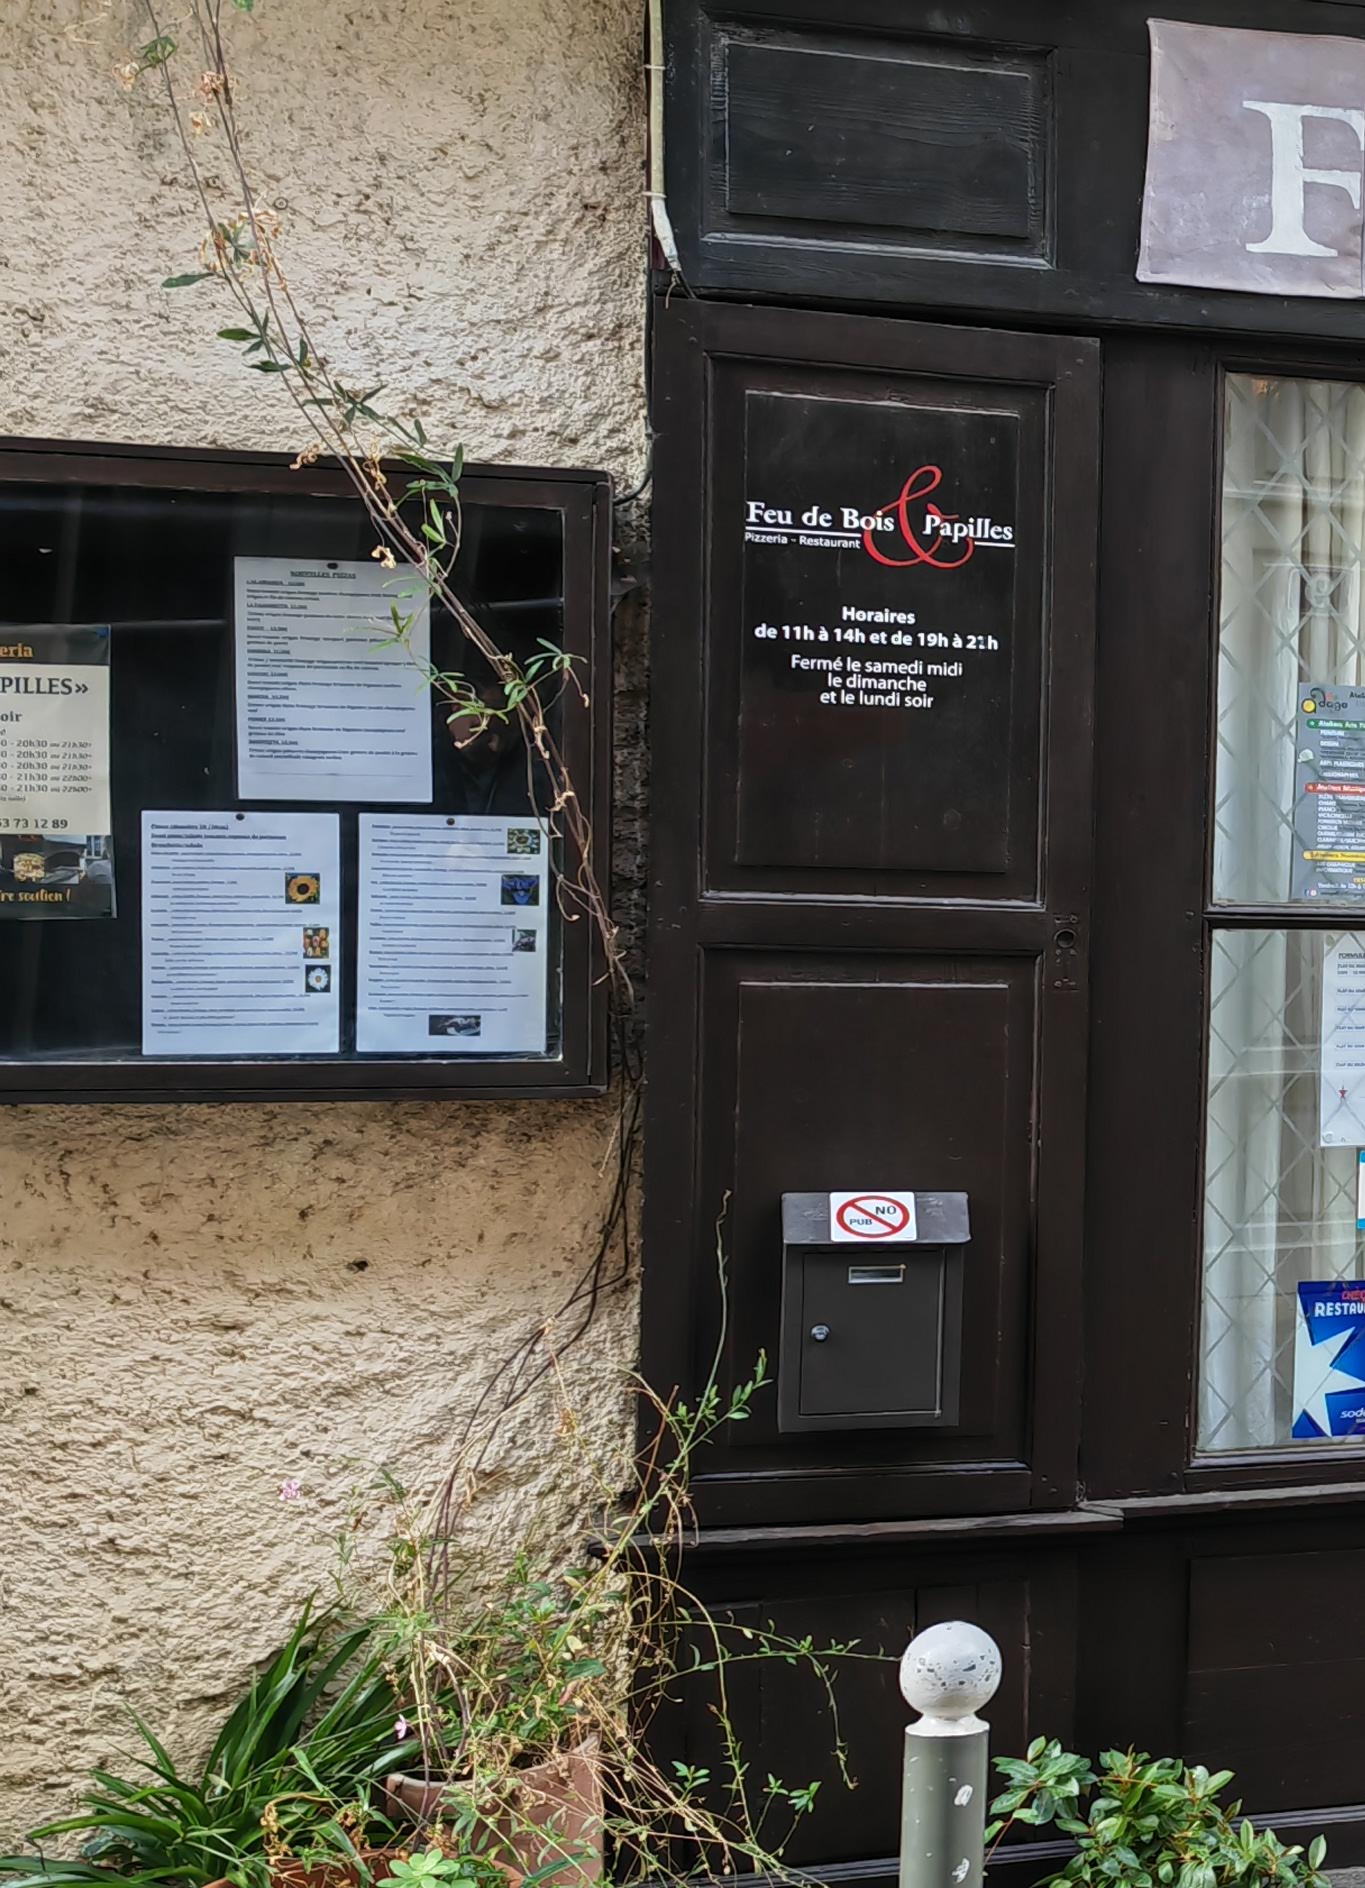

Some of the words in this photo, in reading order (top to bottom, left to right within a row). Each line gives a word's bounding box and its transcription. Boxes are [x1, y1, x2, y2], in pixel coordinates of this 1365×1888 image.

[746, 501, 793, 525] Feu
[802, 506, 832, 527] de
[841, 507, 894, 532] Bois
[923, 514, 1014, 543] Papilles
[745, 532, 788, 544] Pizzeria
[799, 535, 860, 549] Restaurant
[842, 606, 915, 624] Horaires
[754, 623, 778, 639] de
[782, 625, 814, 641] 11h
[818, 625, 830, 642] à
[834, 628, 865, 643] 14h
[869, 632, 887, 644] et
[891, 630, 913, 646] de
[918, 632, 949, 648] 19h
[952, 633, 963, 648] à
[791, 654, 843, 672] Fermé
[846, 657, 862, 672] le
[865, 657, 923, 675] samedi
[927, 662, 962, 676] midi
[828, 673, 843, 688] le
[846, 675, 927, 692] dimanche
[820, 690, 837, 704] et
[841, 689, 856, 704] le
[859, 691, 900, 707] lundi
[904, 693, 933, 708] soir
[14, 818, 28, 828] 73
[34, 819, 48, 828] 12
[52, 819, 68, 829] 89
[875, 1205, 897, 1216] NO
[849, 1218, 873, 1226] PUB
